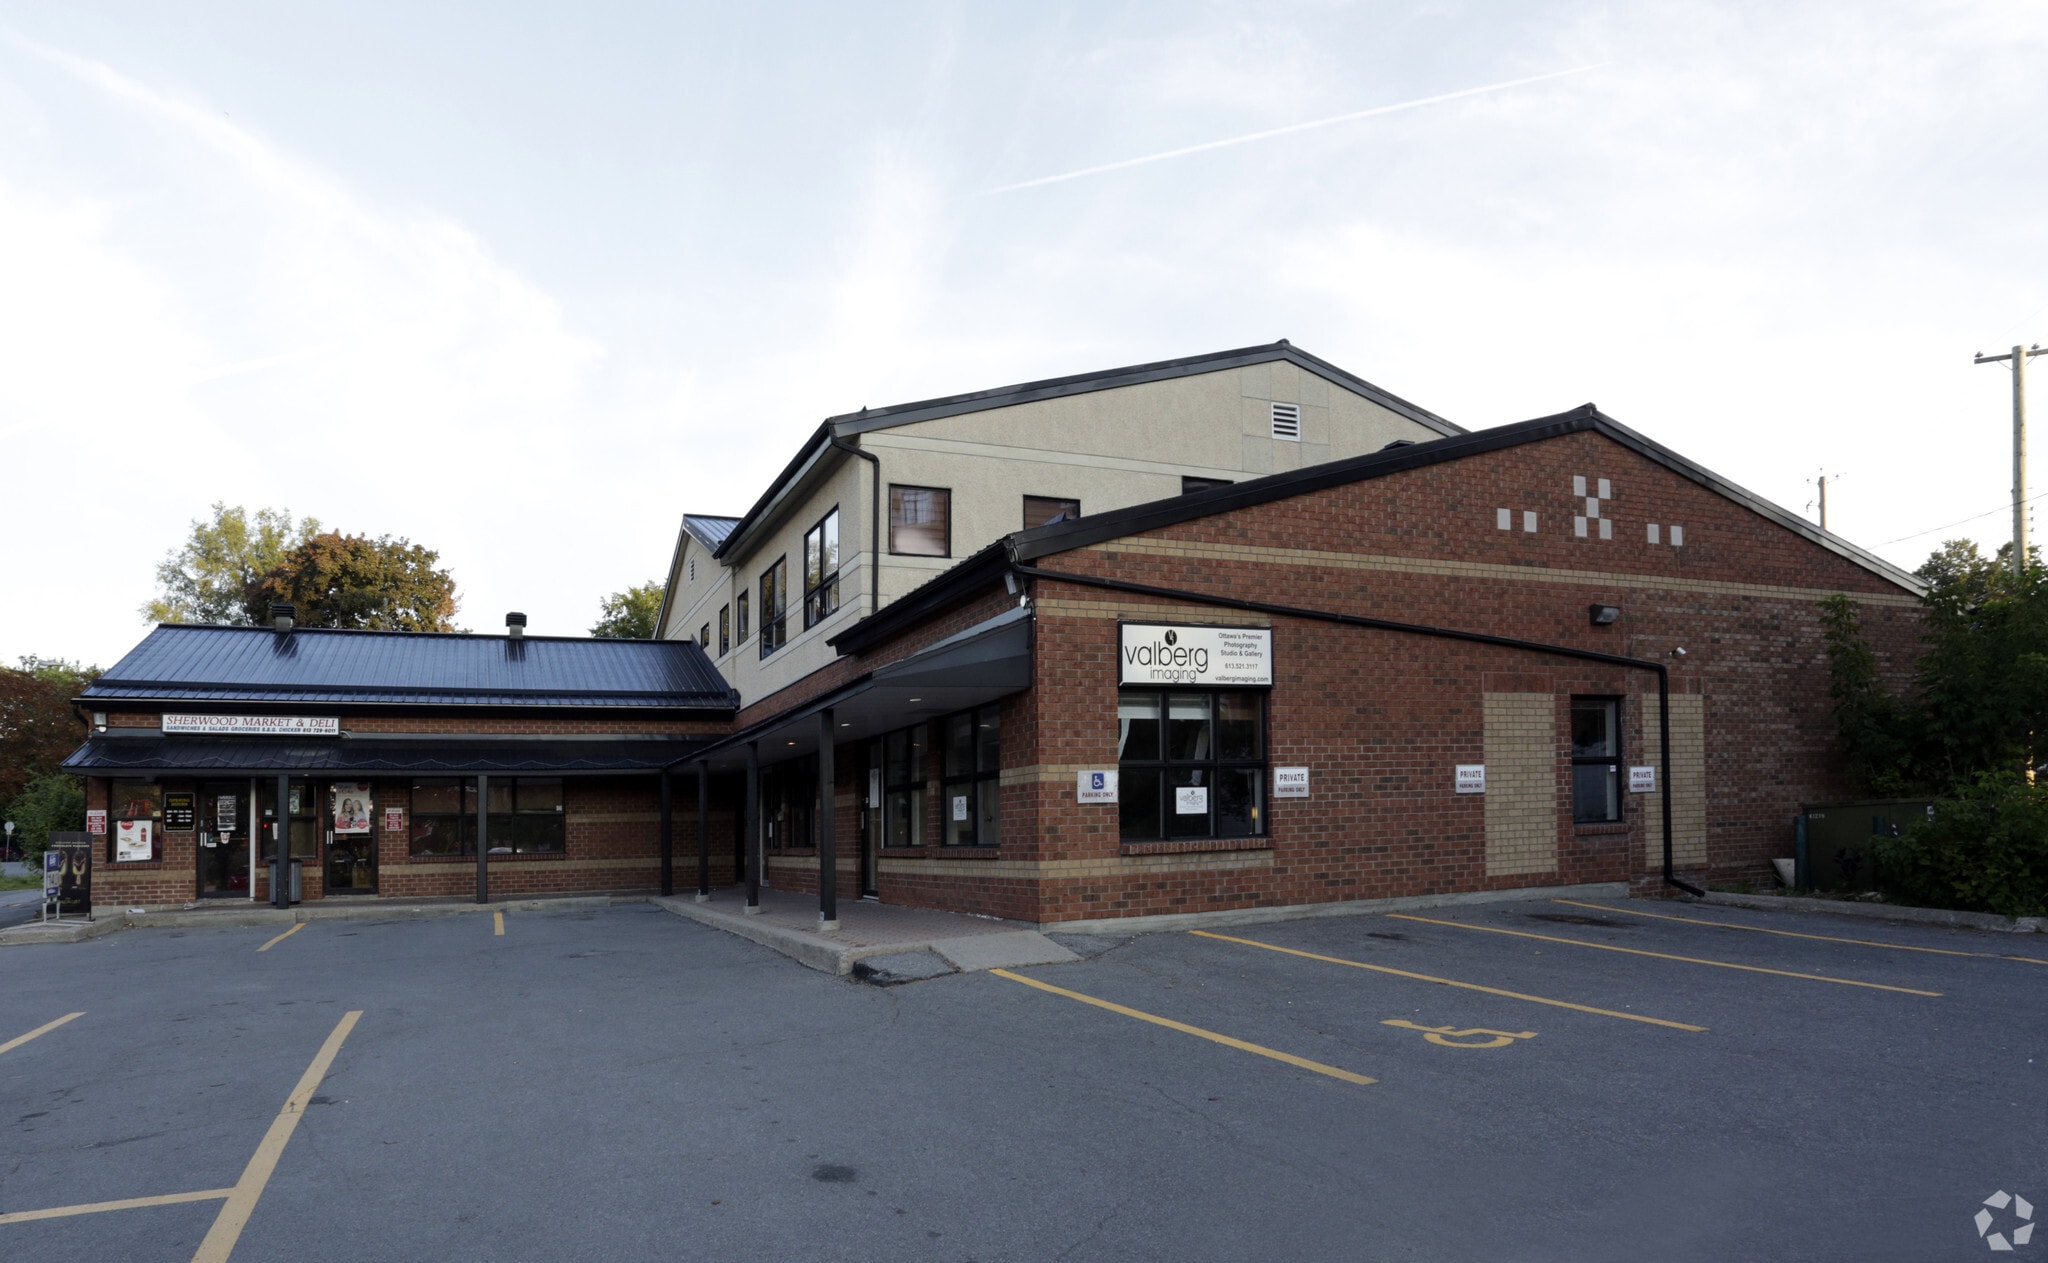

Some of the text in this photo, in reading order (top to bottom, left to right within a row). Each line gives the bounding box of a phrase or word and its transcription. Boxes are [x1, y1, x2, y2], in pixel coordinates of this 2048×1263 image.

[1223, 641, 1257, 649] Photography
[1124, 641, 1208, 673] valberg
[1150, 666, 1196, 683] imaging
[1215, 675, 1269, 683] valbergimaging.com
[166, 715, 335, 728] SHERWOOD MARKET & DELI
[1279, 773, 1305, 782] PRIVATE
[1460, 770, 1482, 778] PRIVATE
[1633, 771, 1652, 779] PRIVATE
[1179, 793, 1203, 803] valberg
